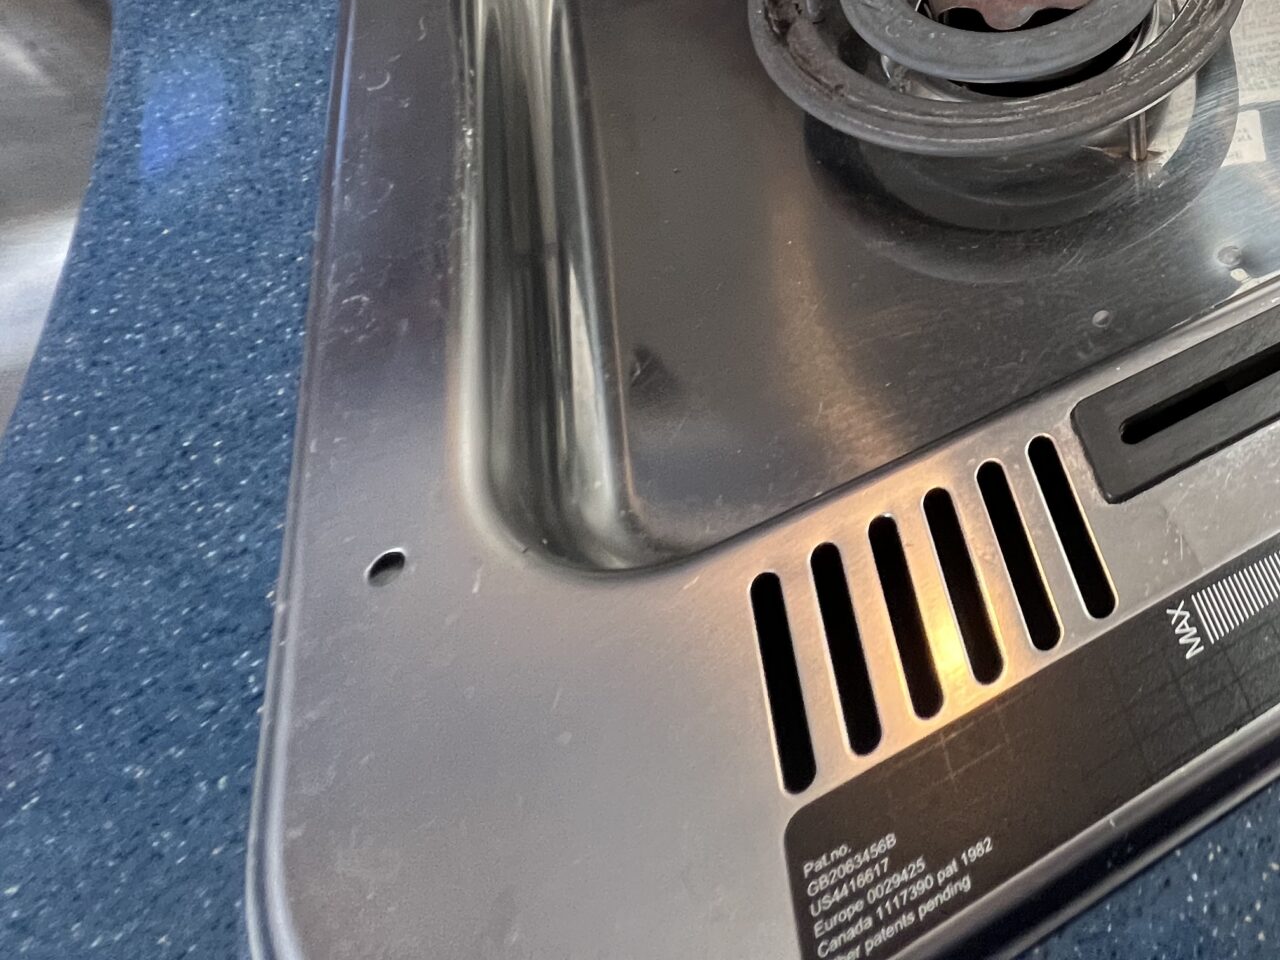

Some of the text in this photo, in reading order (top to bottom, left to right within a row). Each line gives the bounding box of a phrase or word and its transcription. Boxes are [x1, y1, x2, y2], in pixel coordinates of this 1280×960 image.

[1166, 601, 1204, 659] MAX
[814, 856, 926, 939] Europe 0029425
[817, 836, 993, 958] Canada 1117390 pat 1982
[864, 914, 915, 956] patents
[918, 874, 971, 921] pending
